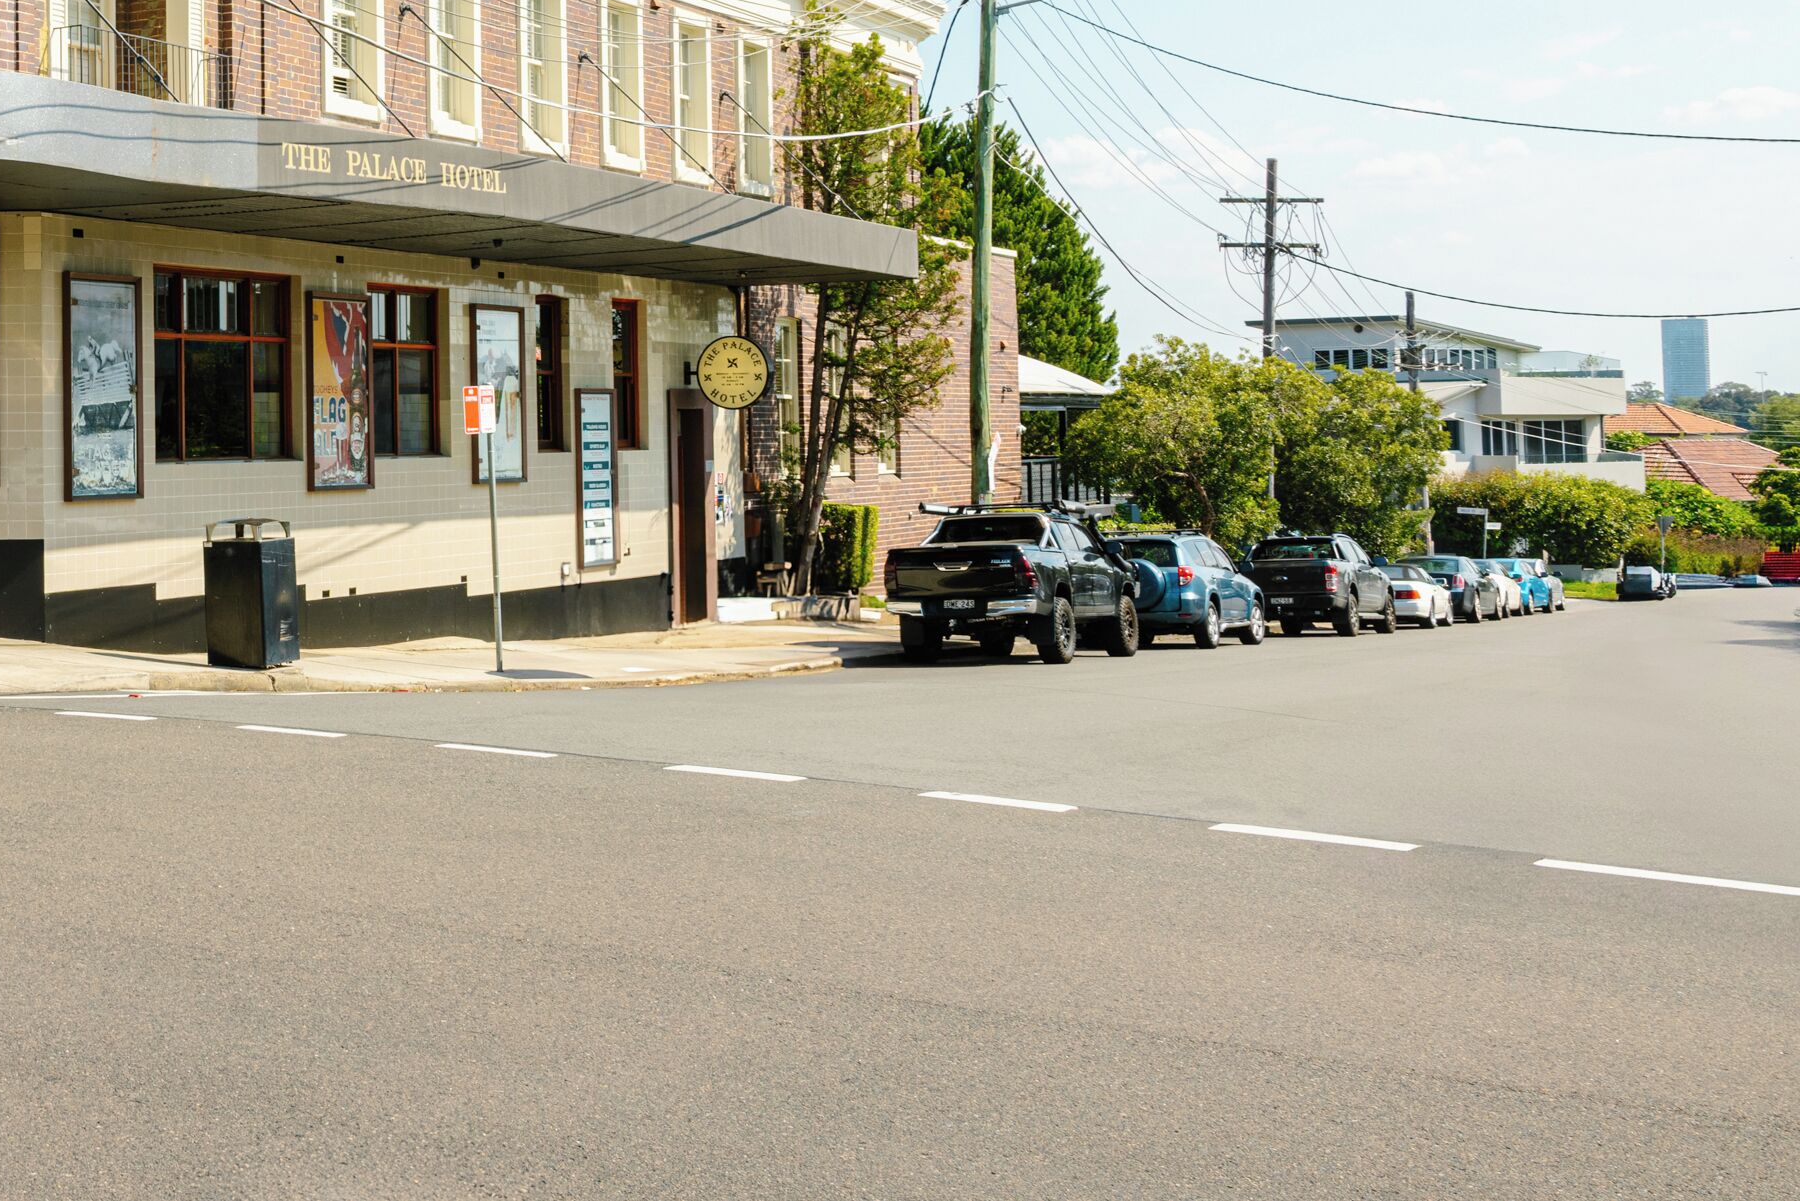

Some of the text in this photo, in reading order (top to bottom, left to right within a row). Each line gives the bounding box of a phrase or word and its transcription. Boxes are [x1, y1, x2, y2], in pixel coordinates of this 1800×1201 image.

[282, 142, 507, 194] THE PALACE HOTEL
[703, 341, 762, 368] THE PALACE
[710, 388, 757, 404] HOTEL
[314, 397, 347, 423] FLAG
